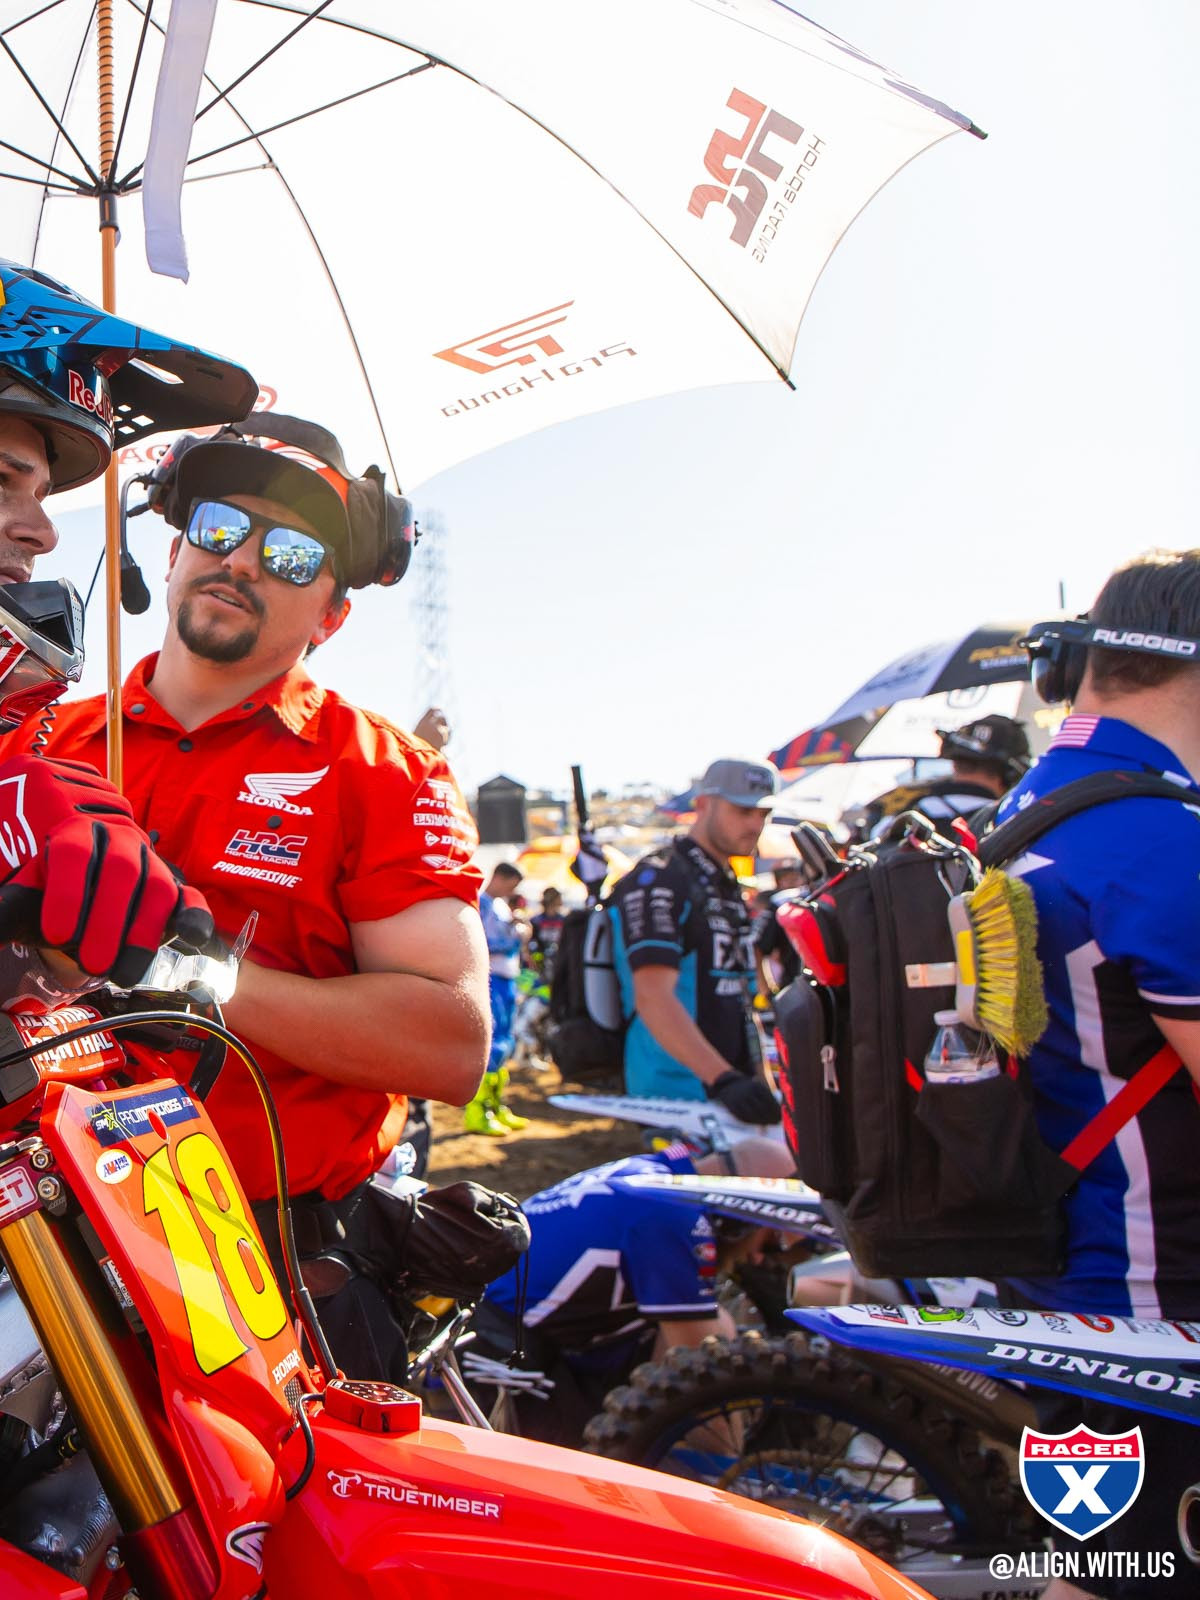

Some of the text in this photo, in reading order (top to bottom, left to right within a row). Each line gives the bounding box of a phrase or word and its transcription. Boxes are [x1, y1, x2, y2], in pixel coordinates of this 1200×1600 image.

[1093, 628, 1197, 655] RUGGED
[237, 791, 314, 816] HONDA
[228, 829, 308, 860] HRC
[212, 861, 302, 888] PROGRESSIVE
[261, 855, 299, 866] RACING
[703, 1193, 822, 1224] DUNLOP
[143, 1132, 287, 1376] 18
[272, 1350, 300, 1384] HONDA
[364, 1482, 500, 1518] TRUETIMBER
